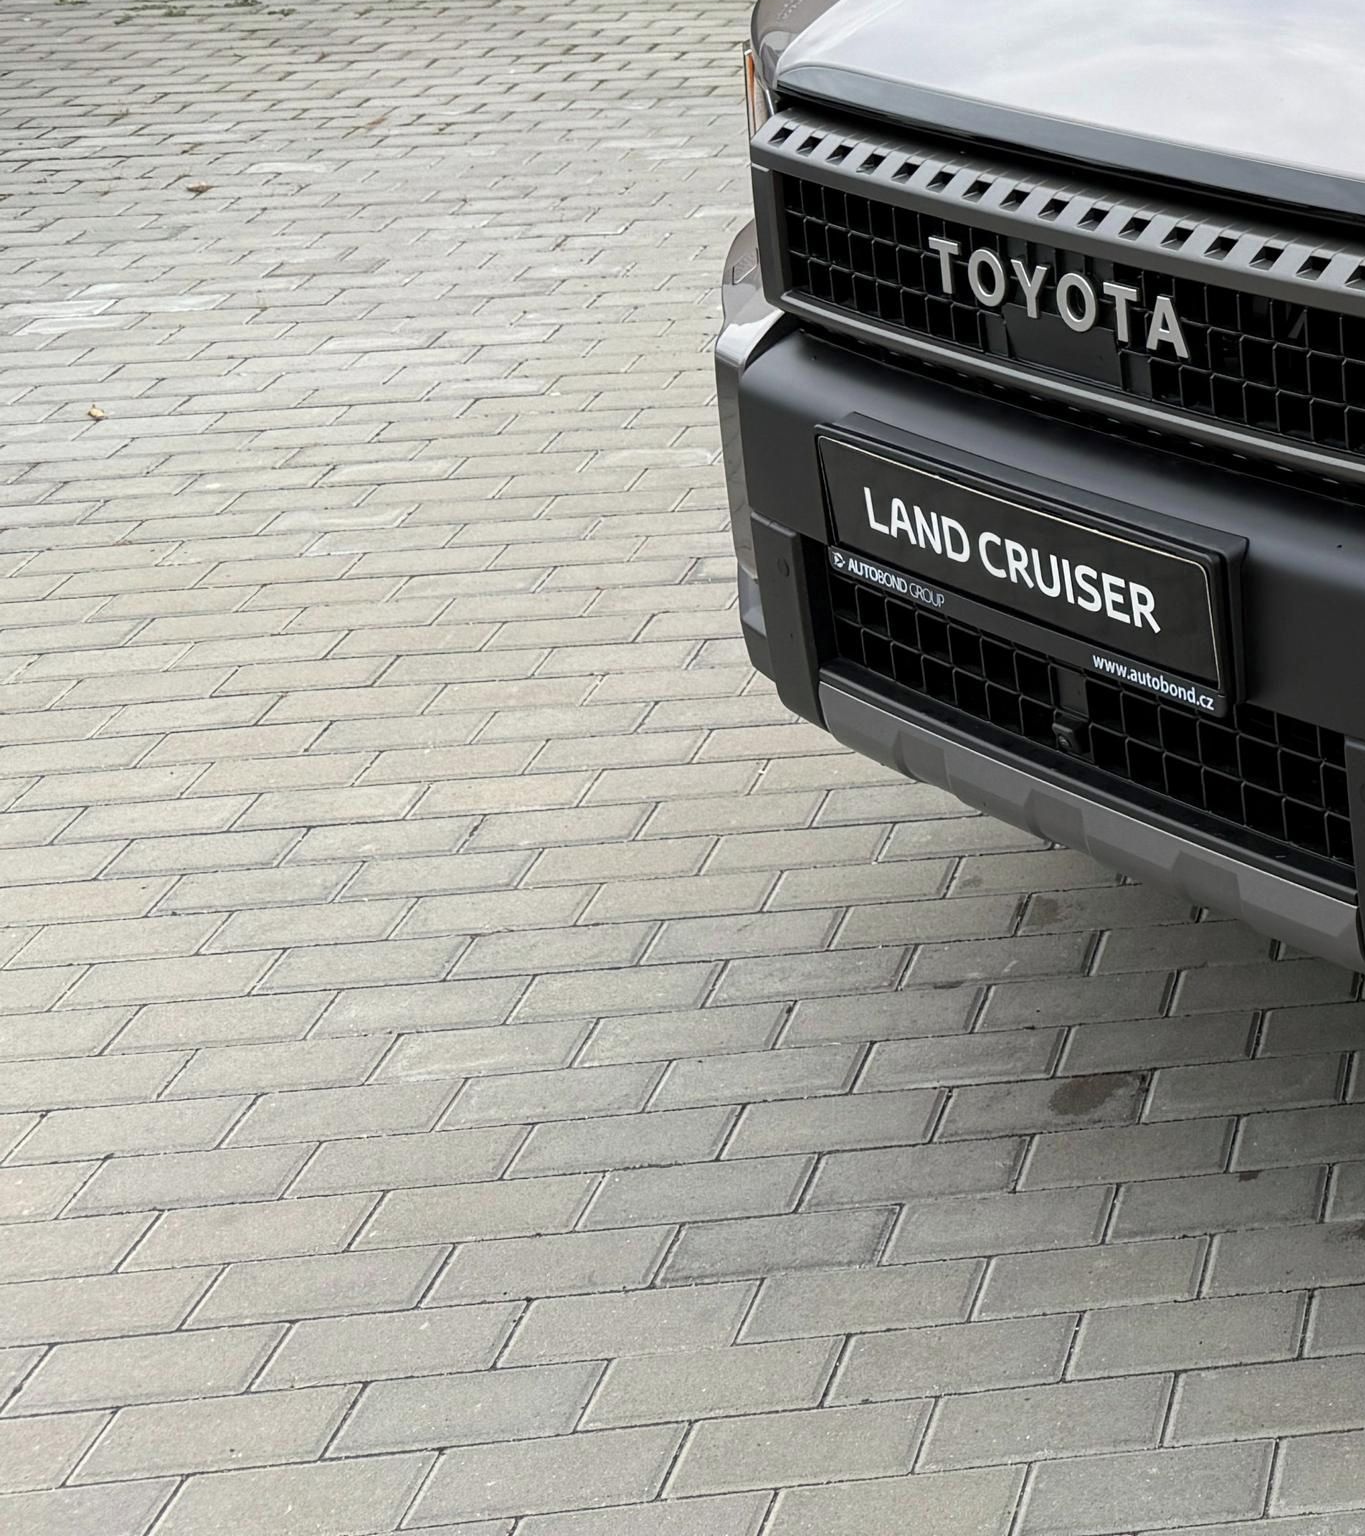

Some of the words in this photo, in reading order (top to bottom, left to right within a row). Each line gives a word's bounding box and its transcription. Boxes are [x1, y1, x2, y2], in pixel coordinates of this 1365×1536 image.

[927, 235, 1190, 360] TOYOTA
[847, 557, 908, 594] AUTOBOND
[908, 582, 945, 608] GROUP
[862, 485, 971, 564] LAND
[977, 530, 1162, 635] CRUISER
[1092, 654, 1215, 712] www.autobond.cz
